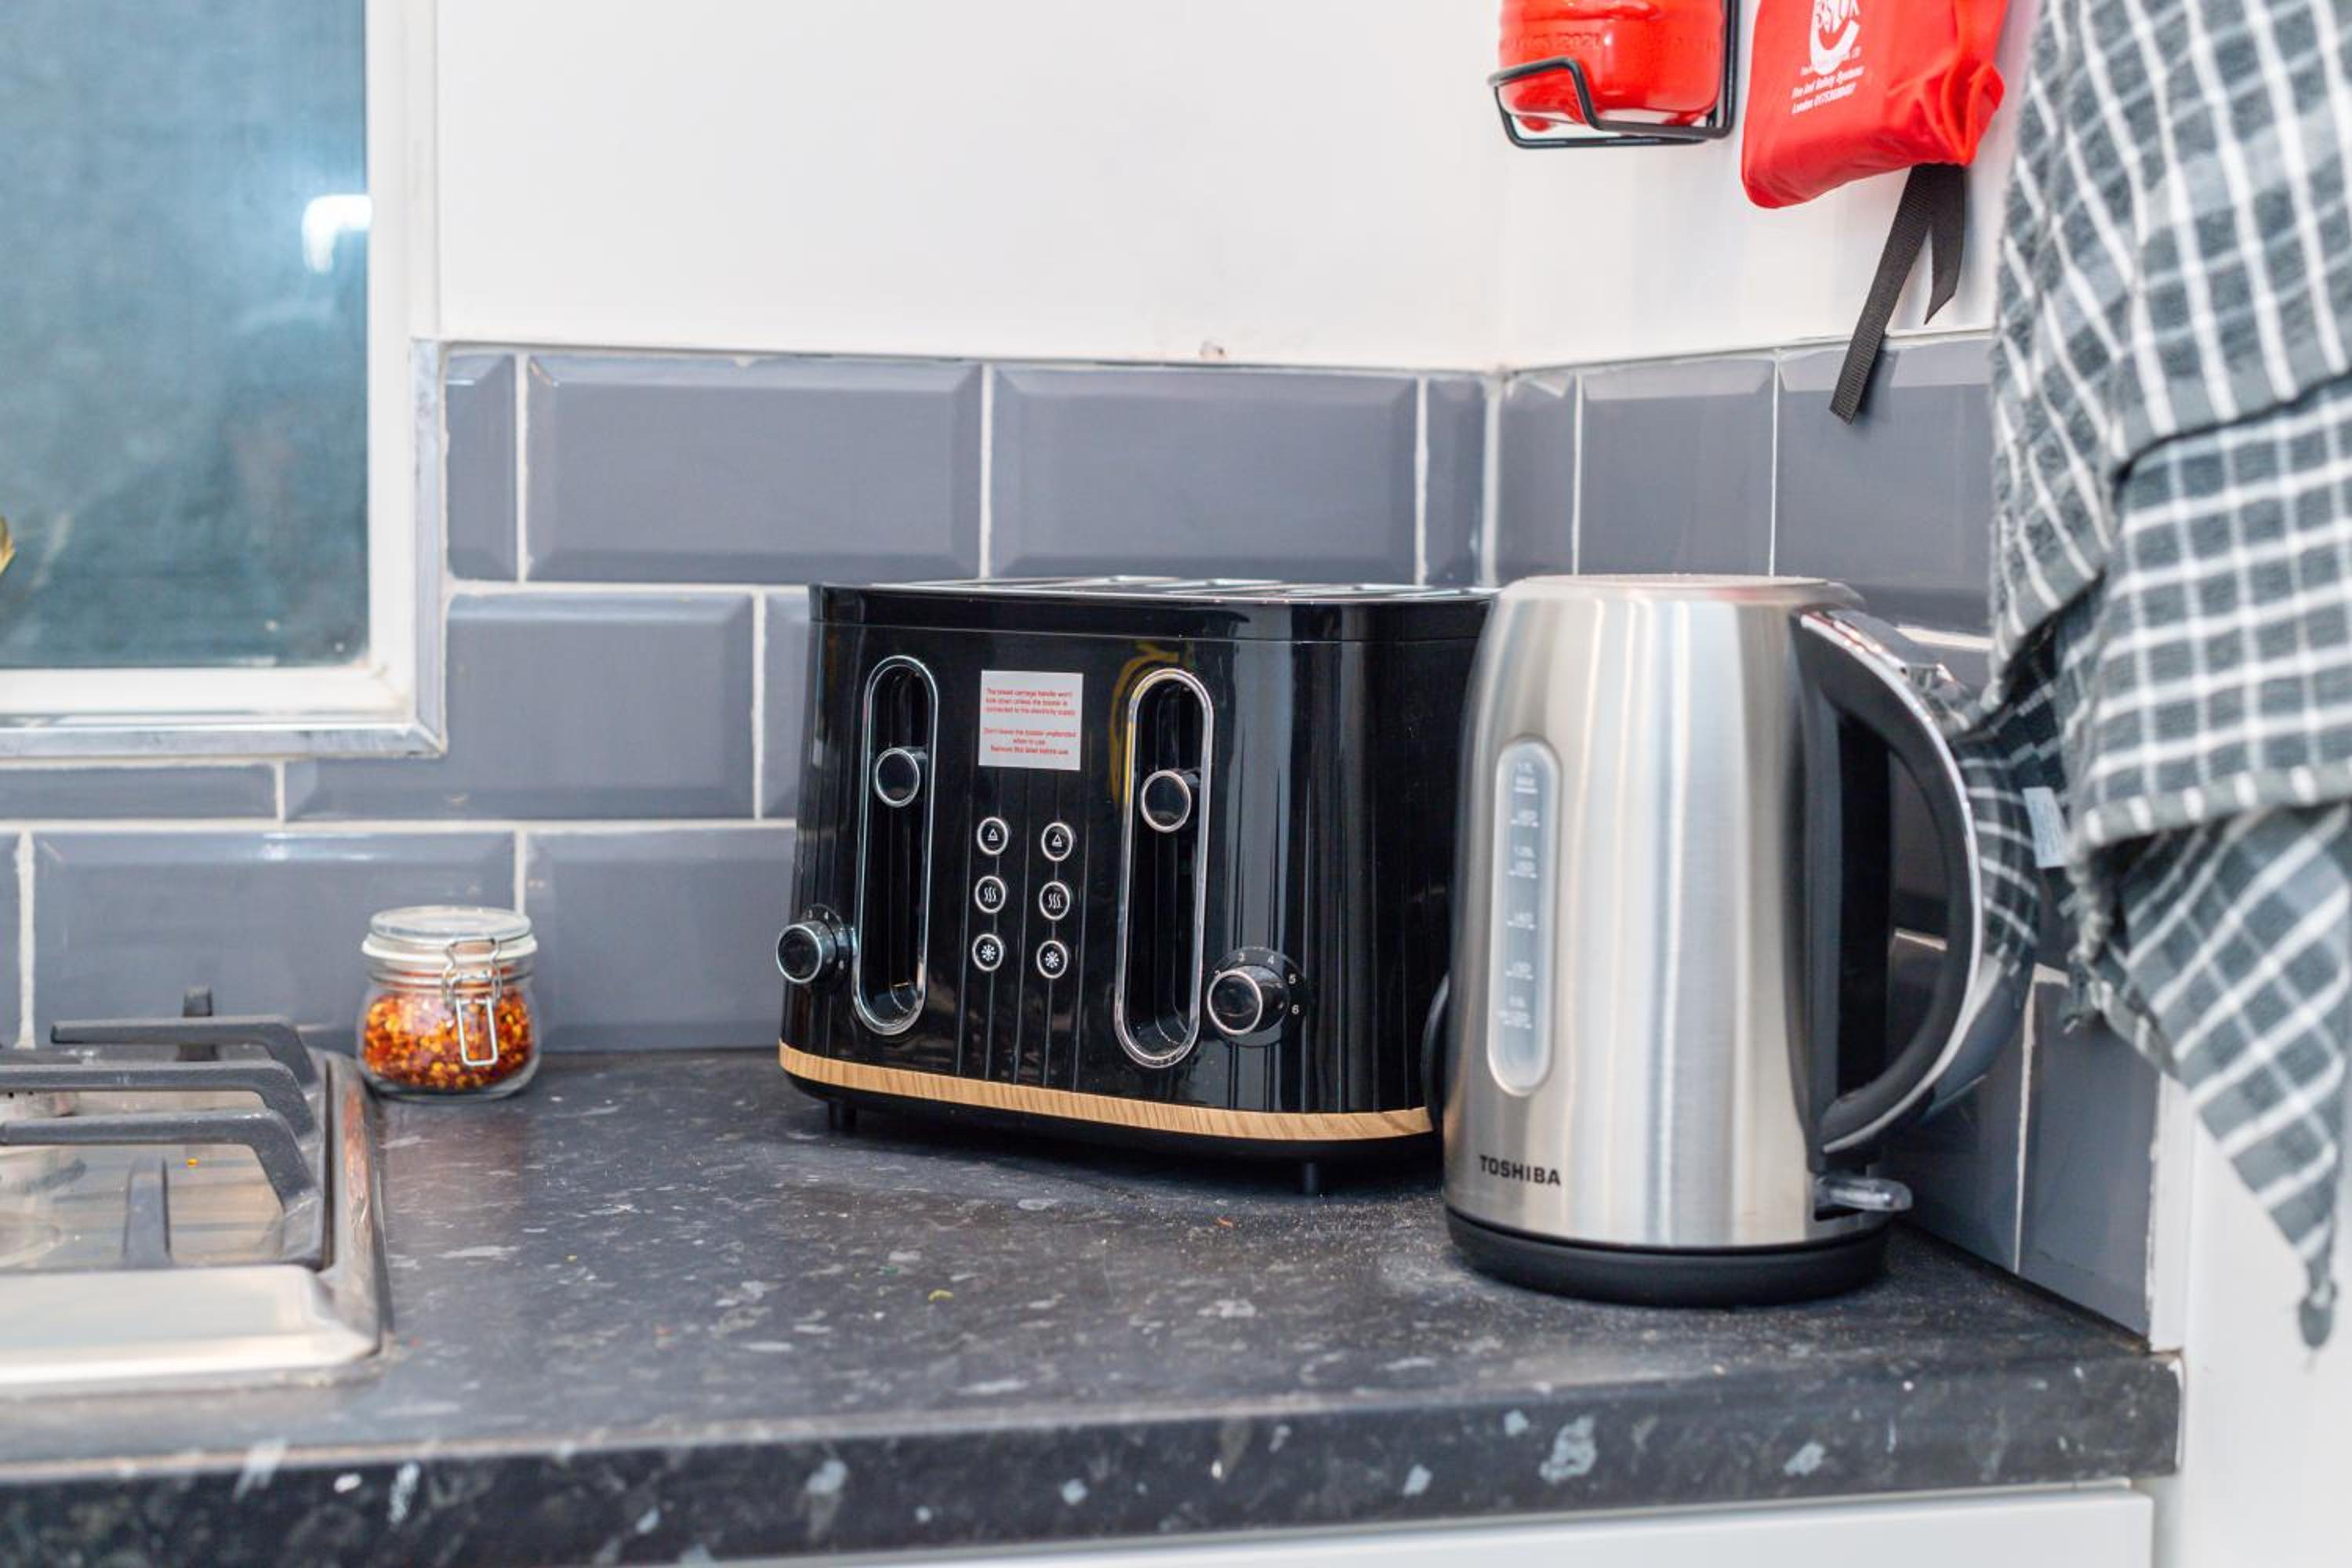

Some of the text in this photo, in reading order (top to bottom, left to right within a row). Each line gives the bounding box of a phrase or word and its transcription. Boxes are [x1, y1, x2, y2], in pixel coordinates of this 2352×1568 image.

[1237, 953, 1245, 961] 3
[1267, 955, 1275, 964] 4
[1288, 975, 1296, 984] 5
[1291, 1004, 1299, 1014] 6
[1479, 1154, 1561, 1186] TOSHIBA
